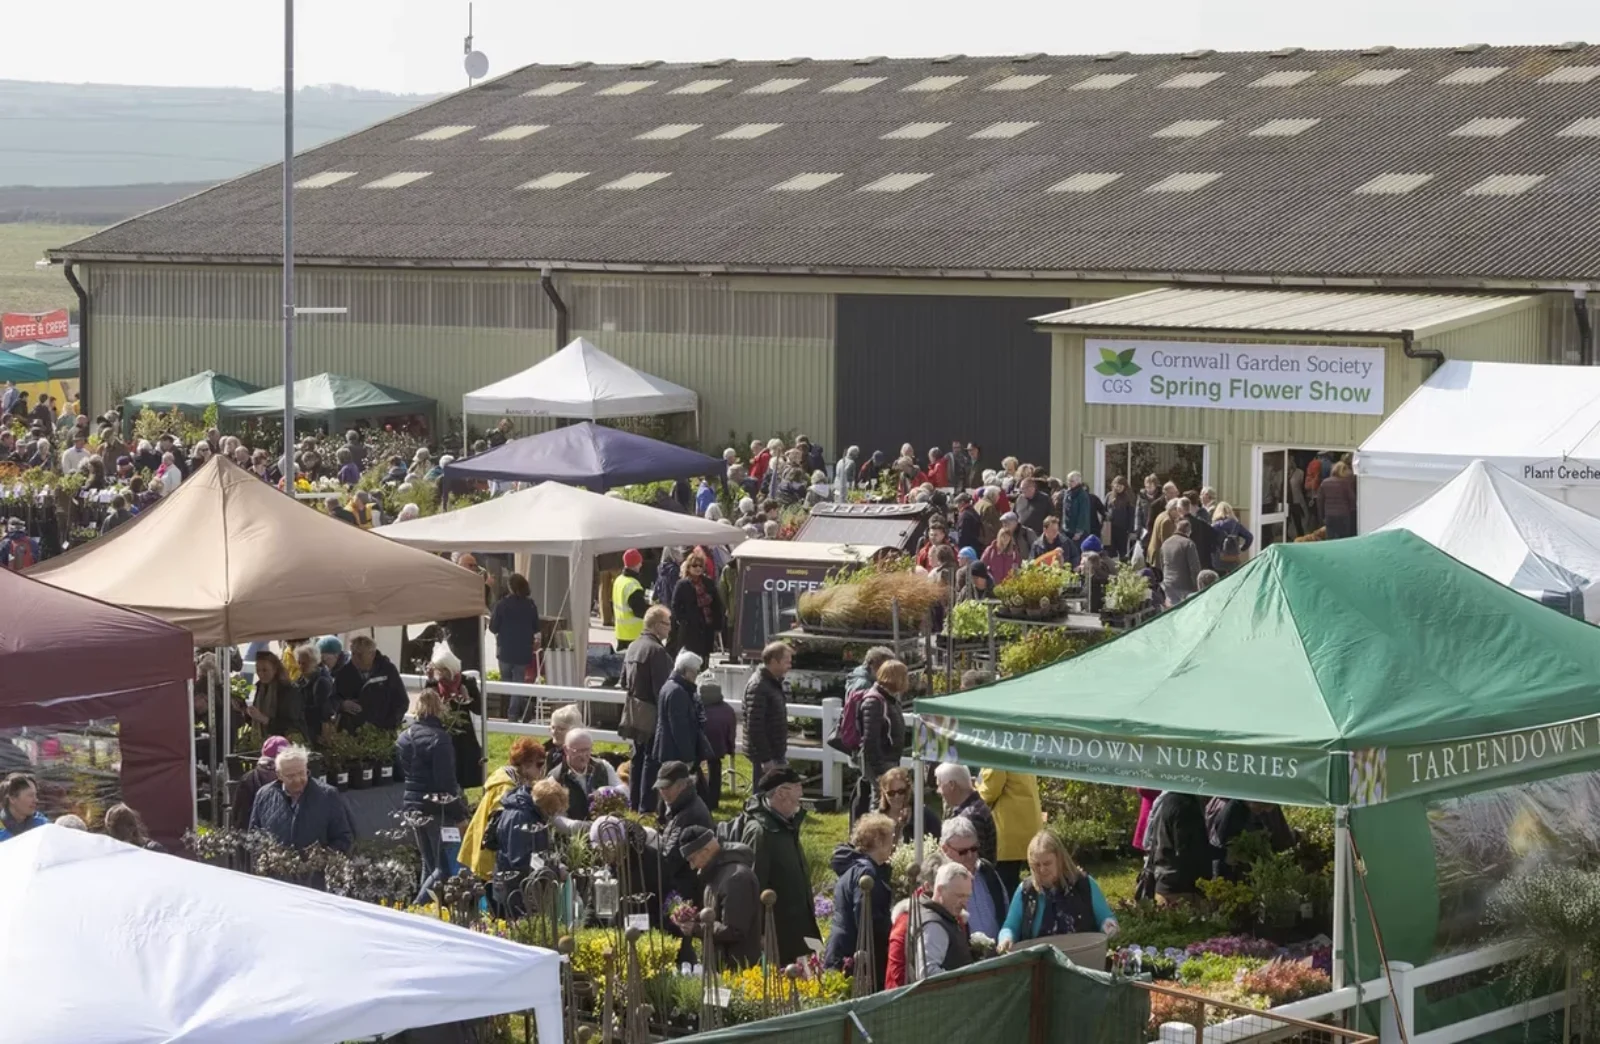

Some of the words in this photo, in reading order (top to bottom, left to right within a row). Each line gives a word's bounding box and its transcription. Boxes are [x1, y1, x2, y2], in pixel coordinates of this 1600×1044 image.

[4, 324, 37, 339] COFFEE
[38, 322, 44, 335] &
[1151, 350, 1230, 370] Cornwall
[1236, 353, 1300, 373] Garden
[1306, 355, 1373, 379] Society
[1102, 378, 1133, 394] CGS
[1150, 374, 1222, 402] Spring
[1229, 378, 1303, 400] Flower
[1309, 380, 1371, 402] Show
[1524, 464, 1554, 480] Plant
[1557, 464, 1600, 480] Creche
[971, 727, 1145, 763] TARTENDOWN
[1156, 745, 1299, 779] NURSERIES
[1407, 720, 1586, 783] TARTENDOWN
